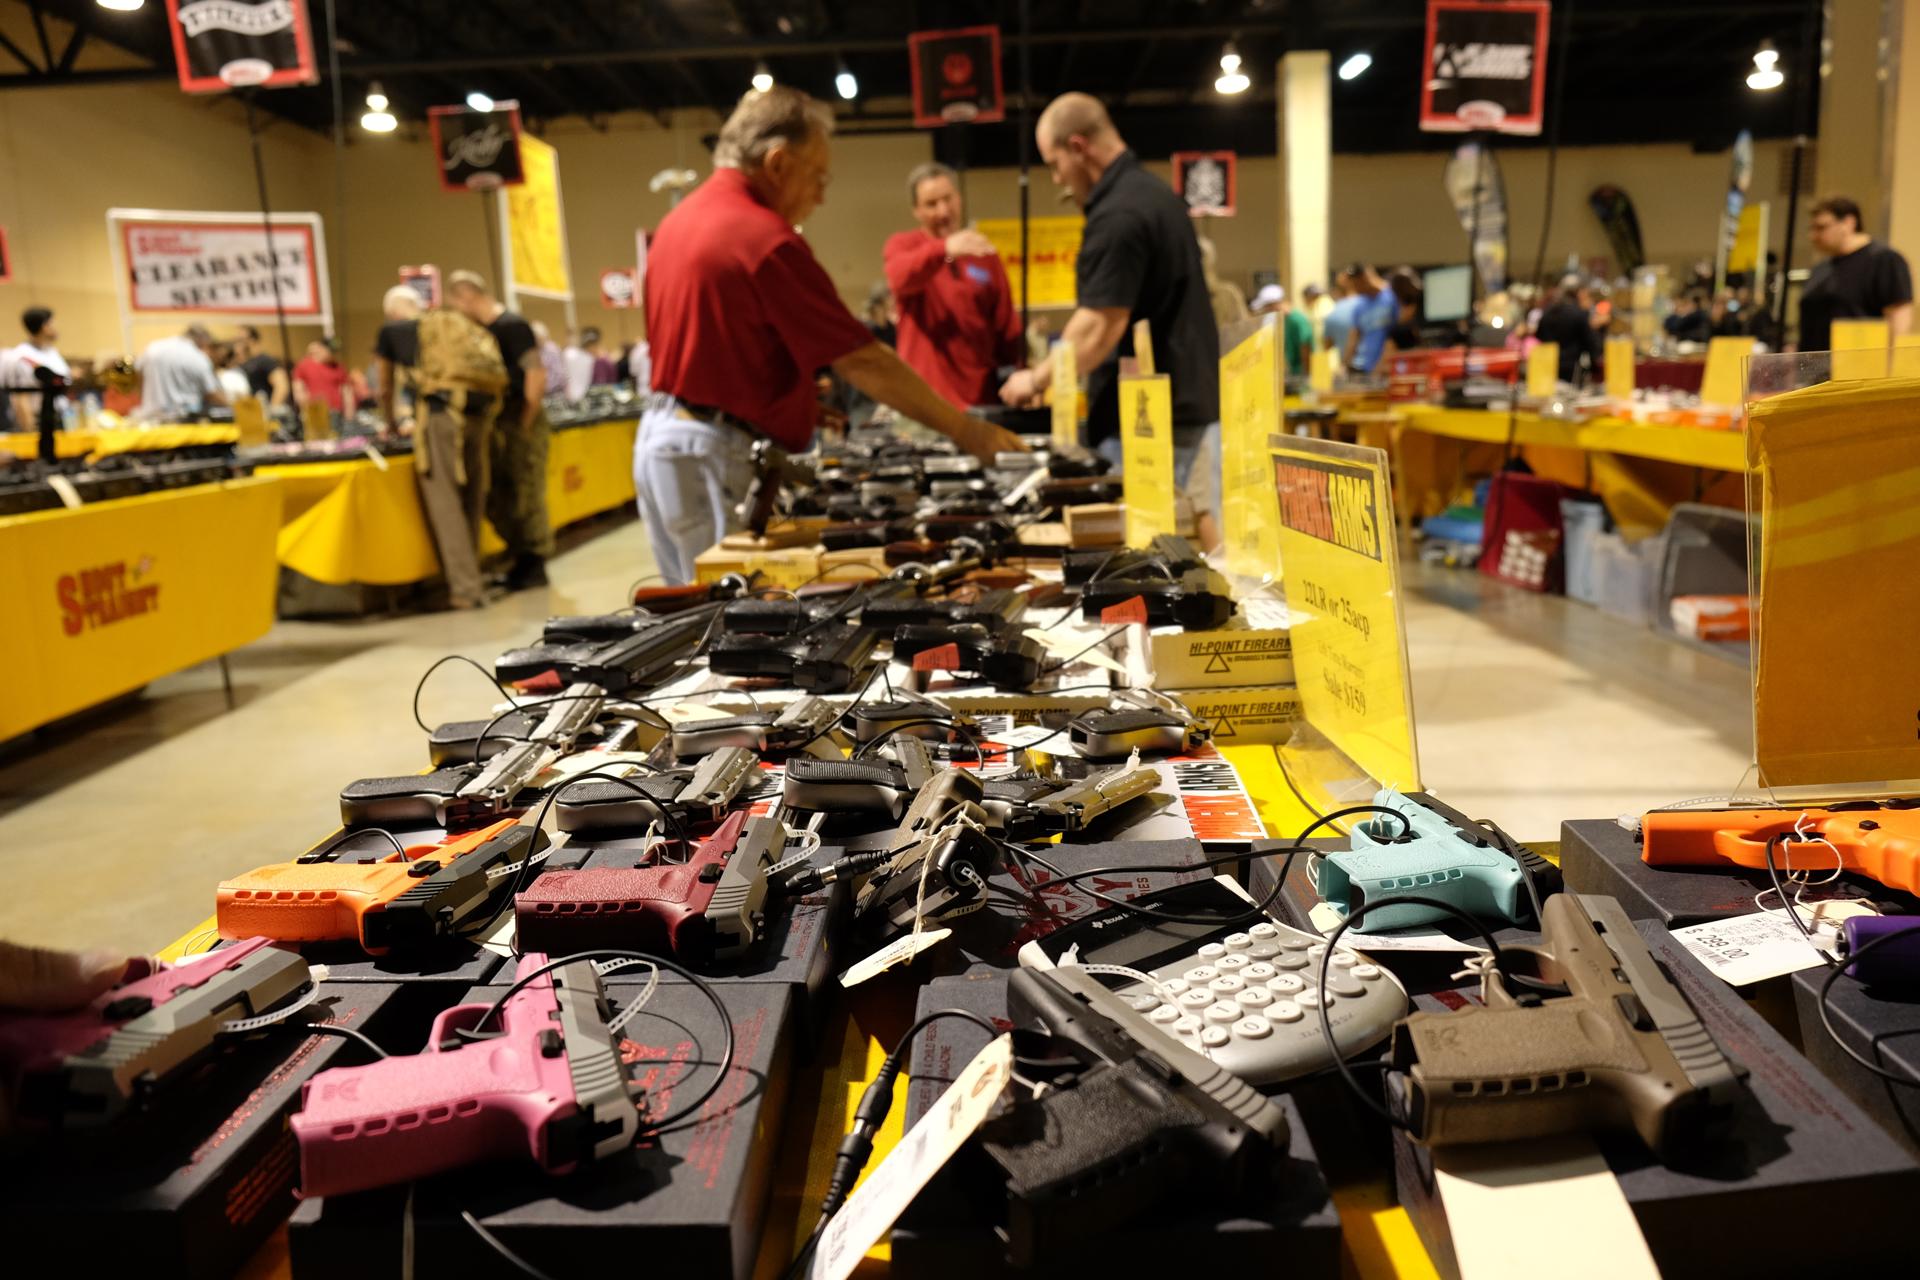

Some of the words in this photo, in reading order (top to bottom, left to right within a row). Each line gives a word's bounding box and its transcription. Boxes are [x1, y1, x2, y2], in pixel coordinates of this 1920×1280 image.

[131, 248, 305, 285] CLEARANCE
[171, 273, 300, 310] SECTION
[1328, 472, 1376, 558] ARMS
[1328, 598, 1339, 619] or
[1190, 639, 1242, 652] HI-POINT
[1243, 637, 1292, 651] FIREARM
[1195, 703, 1247, 717] HI-POINT
[1249, 701, 1298, 714] FIREARM
[1172, 763, 1241, 791] ARMS
[1696, 934, 1750, 960] 299.00
[1194, 969, 1209, 977] 8
[1252, 966, 1266, 974] 6
[1246, 991, 1263, 1000] 2
[1243, 1021, 1260, 1030] 0
